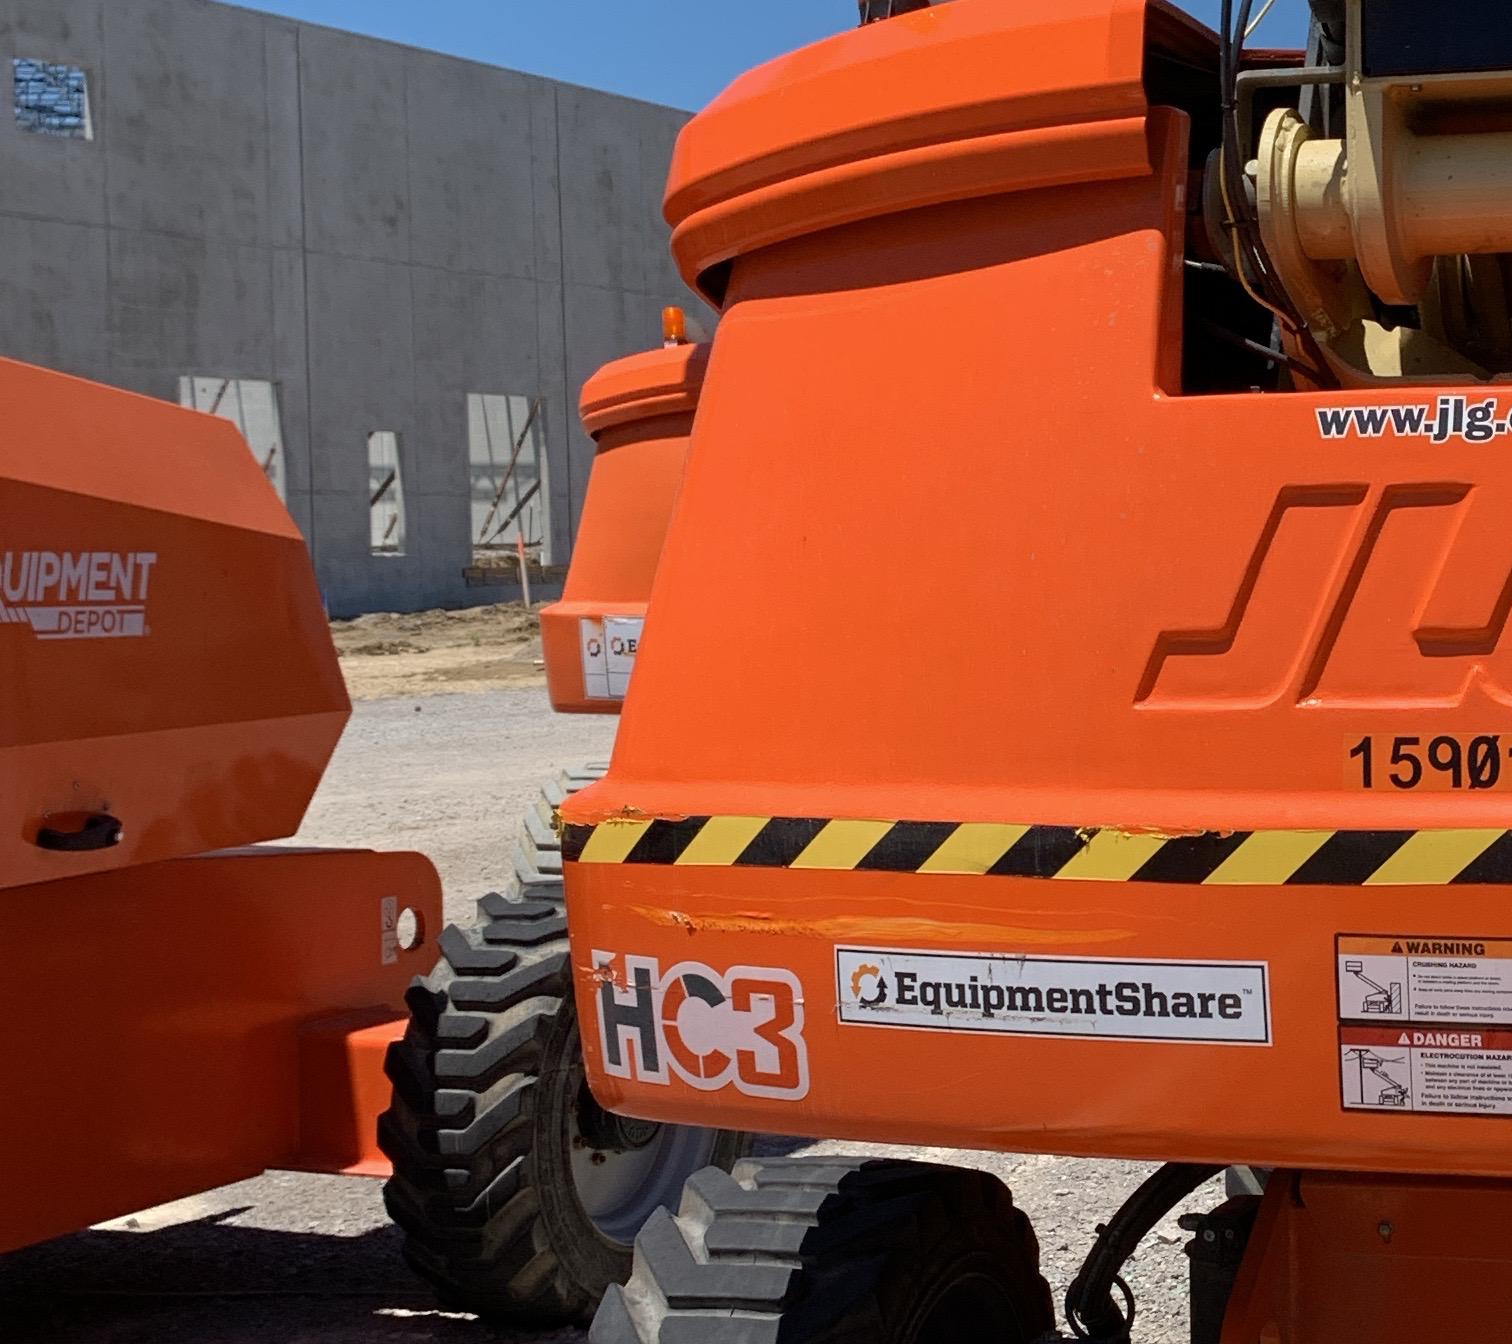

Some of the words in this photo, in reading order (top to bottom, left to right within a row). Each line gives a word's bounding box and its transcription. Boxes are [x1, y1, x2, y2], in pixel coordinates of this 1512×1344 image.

[0, 551, 157, 602] UIPMENT
[57, 609, 134, 633] DEPOT
[1407, 941, 1486, 956] WARNING
[895, 970, 1243, 1019] EquipmentShare
[594, 952, 807, 1097] HC3
[1413, 1032, 1482, 1047] DANGER
